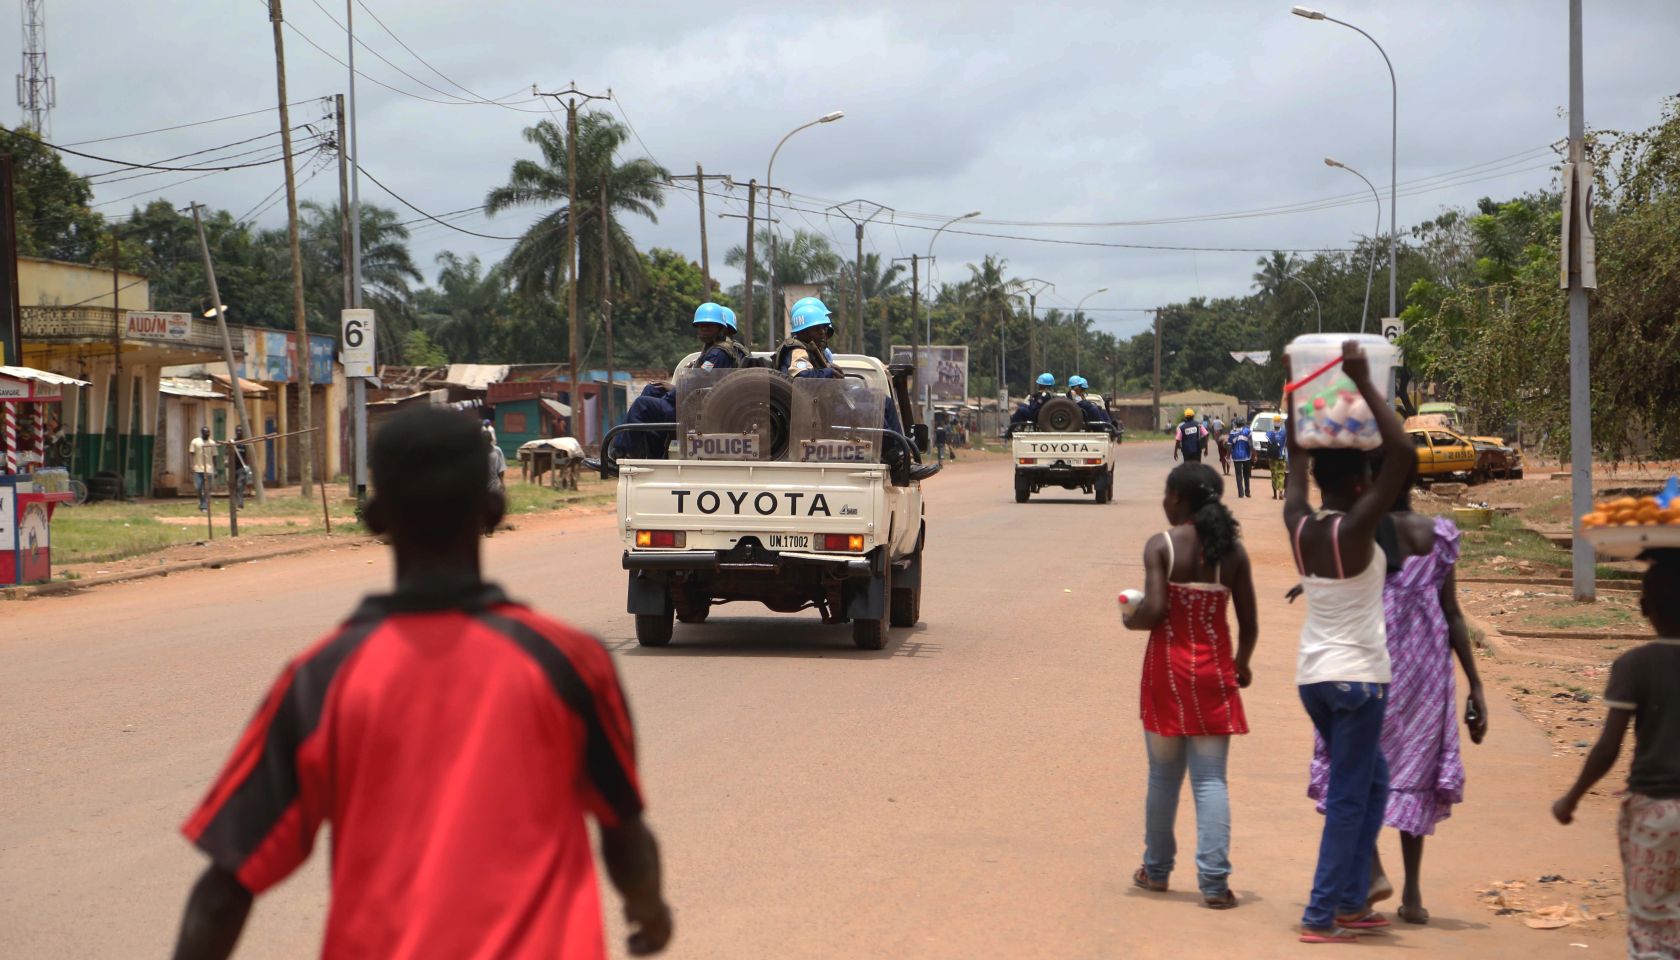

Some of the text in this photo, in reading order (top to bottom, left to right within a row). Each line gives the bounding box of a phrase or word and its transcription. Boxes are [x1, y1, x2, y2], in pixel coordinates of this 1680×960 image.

[793, 315, 805, 326] UN
[692, 438, 753, 455] POLICE
[804, 444, 865, 461] POLICE
[1031, 443, 1089, 453] TOYOTA
[671, 490, 832, 516] TOYOTA
[768, 535, 809, 549] UN.17002
